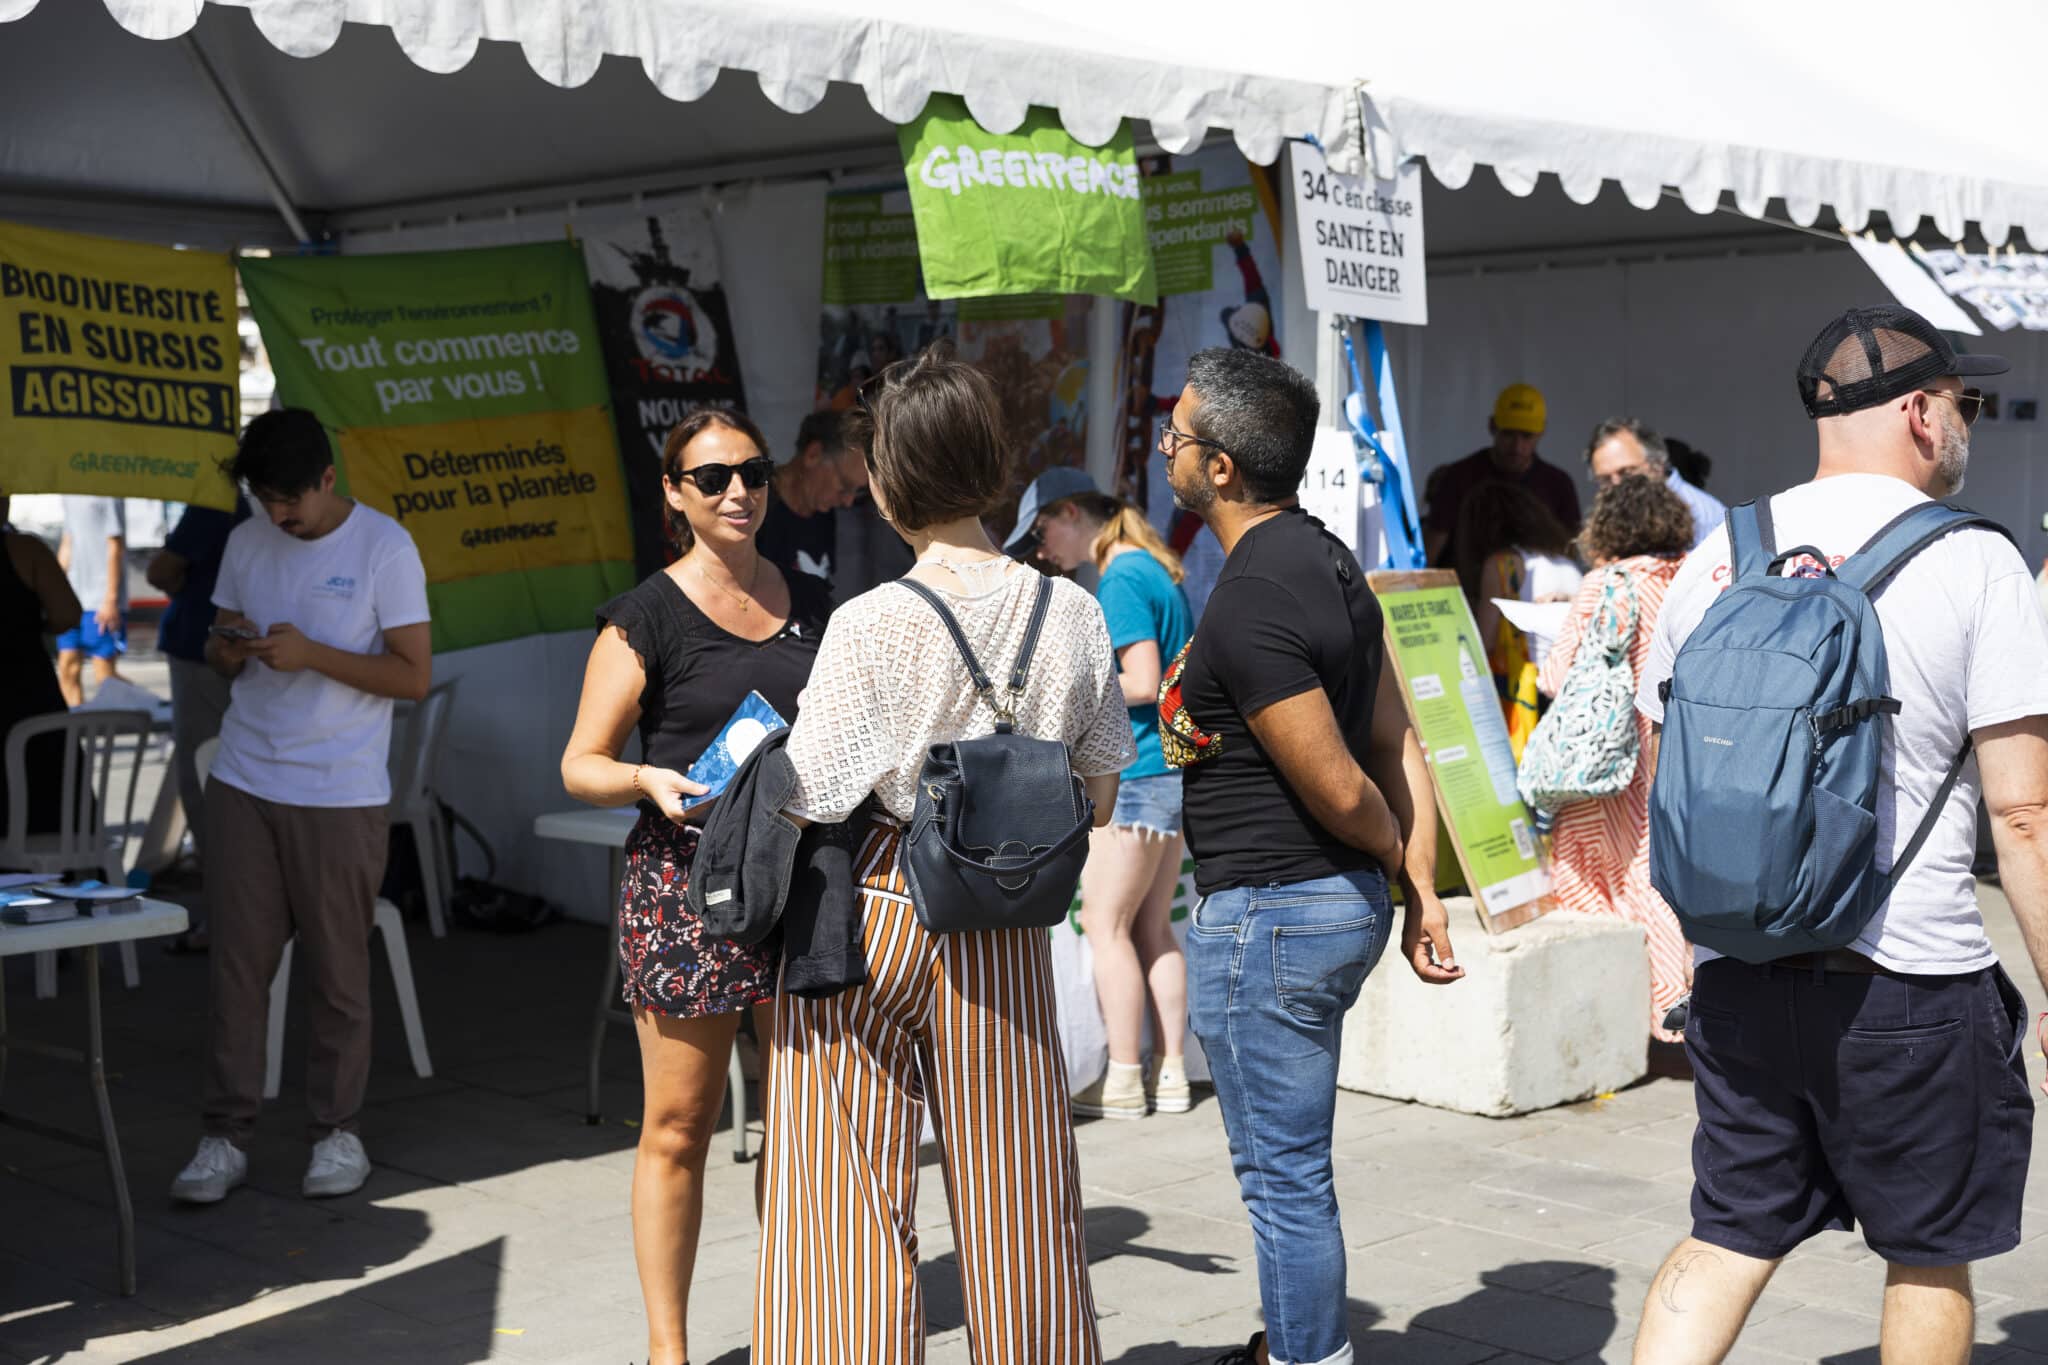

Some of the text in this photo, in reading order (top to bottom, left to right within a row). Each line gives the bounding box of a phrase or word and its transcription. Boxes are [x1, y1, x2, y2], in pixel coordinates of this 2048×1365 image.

[919, 145, 1140, 200] GREENPEACE
[1302, 170, 1328, 203] 34
[1346, 191, 1363, 209] en
[1366, 190, 1413, 217] classe
[1168, 191, 1252, 219] sommes
[1316, 220, 1404, 257] SANTÉ EN
[1, 262, 224, 323] BIODIVERSITÉ
[1326, 258, 1401, 293] DANGER
[311, 304, 393, 328] Protéger
[19, 312, 223, 372] EN SURSIS
[301, 328, 580, 372] Tout commence
[375, 360, 544, 412] par vous !
[630, 357, 733, 385] TOTAL
[23, 370, 233, 429] AGISSONS !
[70, 451, 200, 478] GREENPEACE
[403, 440, 566, 481] Déterminés
[392, 469, 597, 520] pour la planète
[461, 520, 559, 548] GREENPEACE
